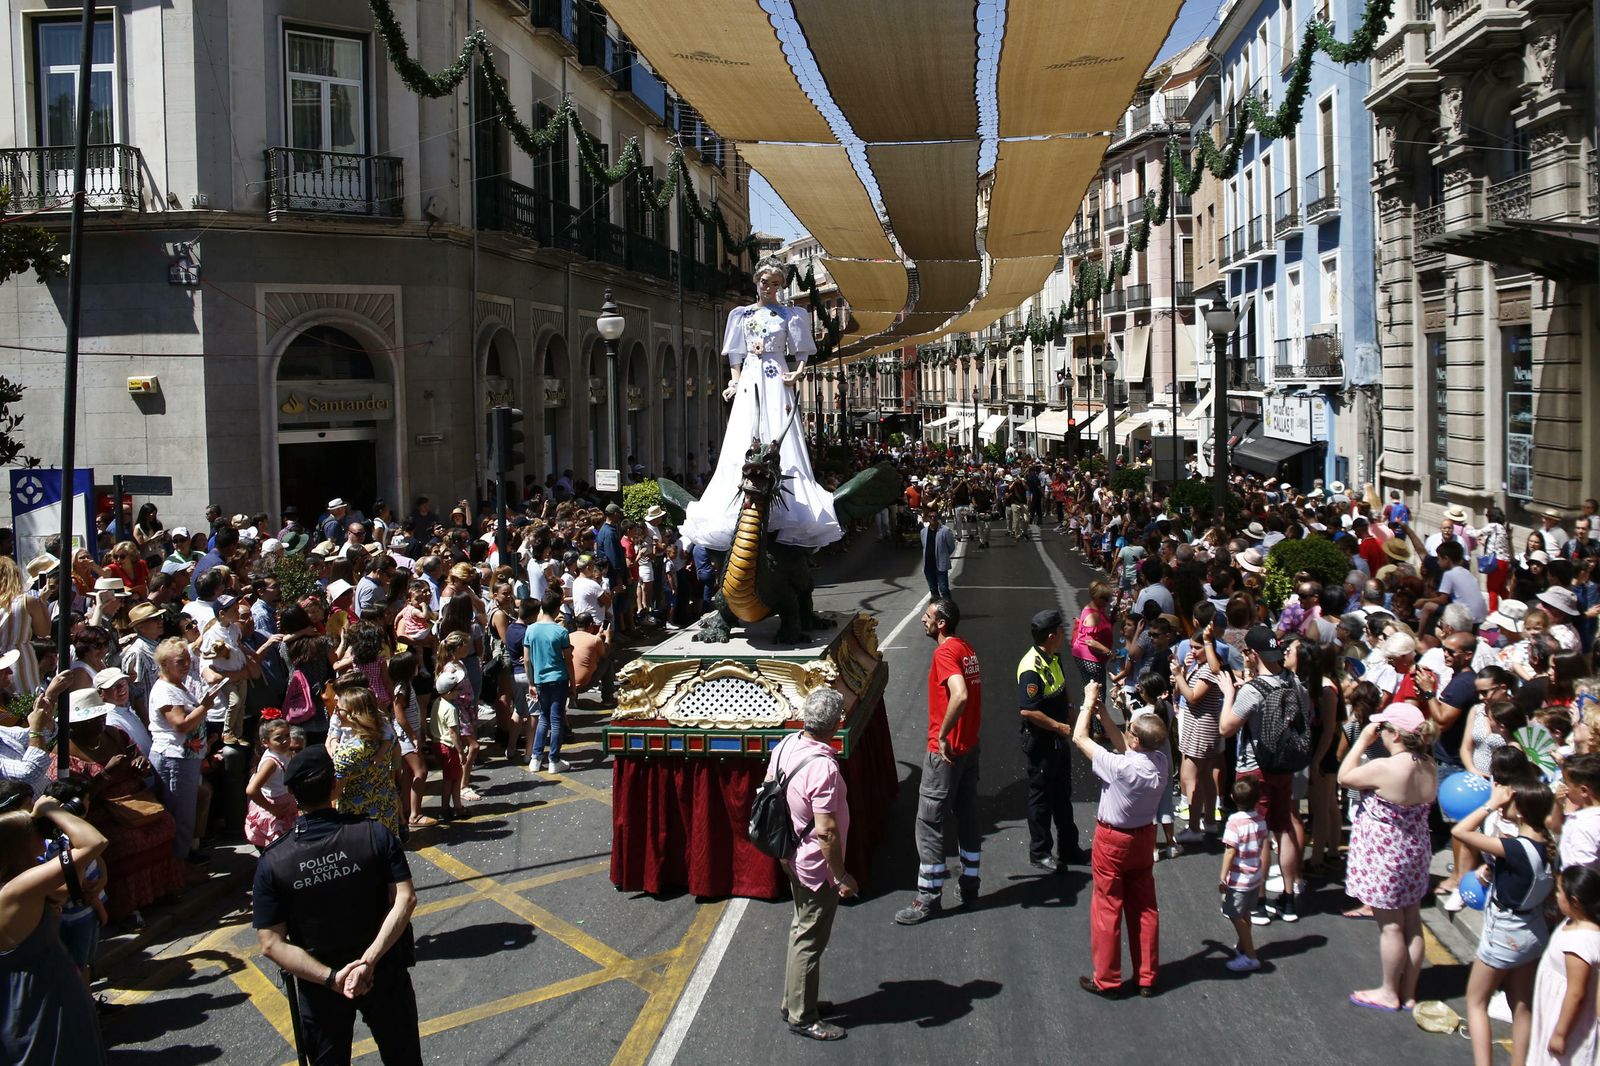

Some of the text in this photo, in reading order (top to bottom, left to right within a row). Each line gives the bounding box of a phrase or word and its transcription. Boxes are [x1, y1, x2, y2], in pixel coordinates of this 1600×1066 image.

[308, 394, 393, 413] Santander
[299, 850, 348, 872] POLICIA
[312, 862, 339, 876] LOCAL
[293, 863, 361, 890] GRANADA
